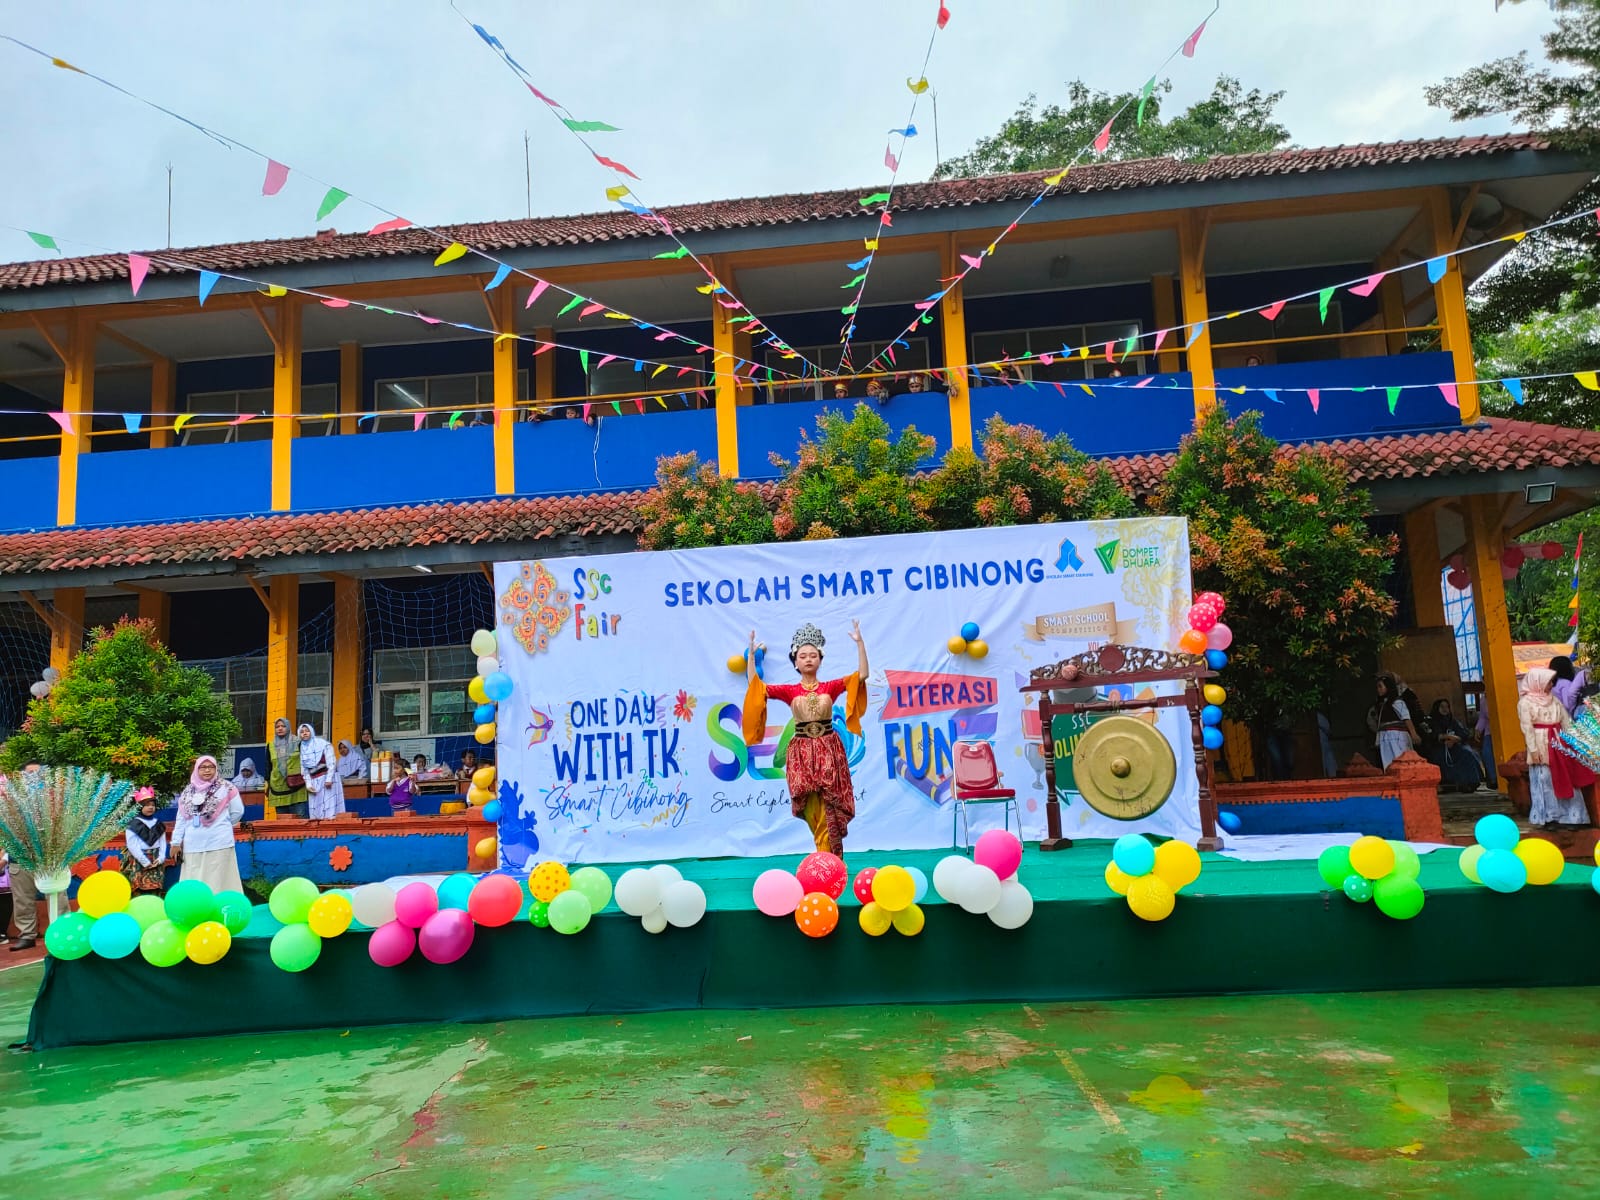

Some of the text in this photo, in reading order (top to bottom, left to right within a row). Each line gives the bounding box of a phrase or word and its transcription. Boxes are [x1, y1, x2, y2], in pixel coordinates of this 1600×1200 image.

[1122, 546, 1159, 558] DOMPET
[1123, 558, 1161, 568] DHUAFA
[664, 558, 1045, 607] SEKOLAH SMART CIBINONG
[574, 603, 621, 640] Fair
[1043, 611, 1110, 628] SMART SCHOOL
[570, 694, 656, 728] ONE DAY
[896, 680, 994, 708] LITERASI
[552, 728, 680, 783] WITH TK
[884, 719, 957, 779] FUN
[545, 784, 614, 822] Smart
[710, 791, 753, 813] Smart
